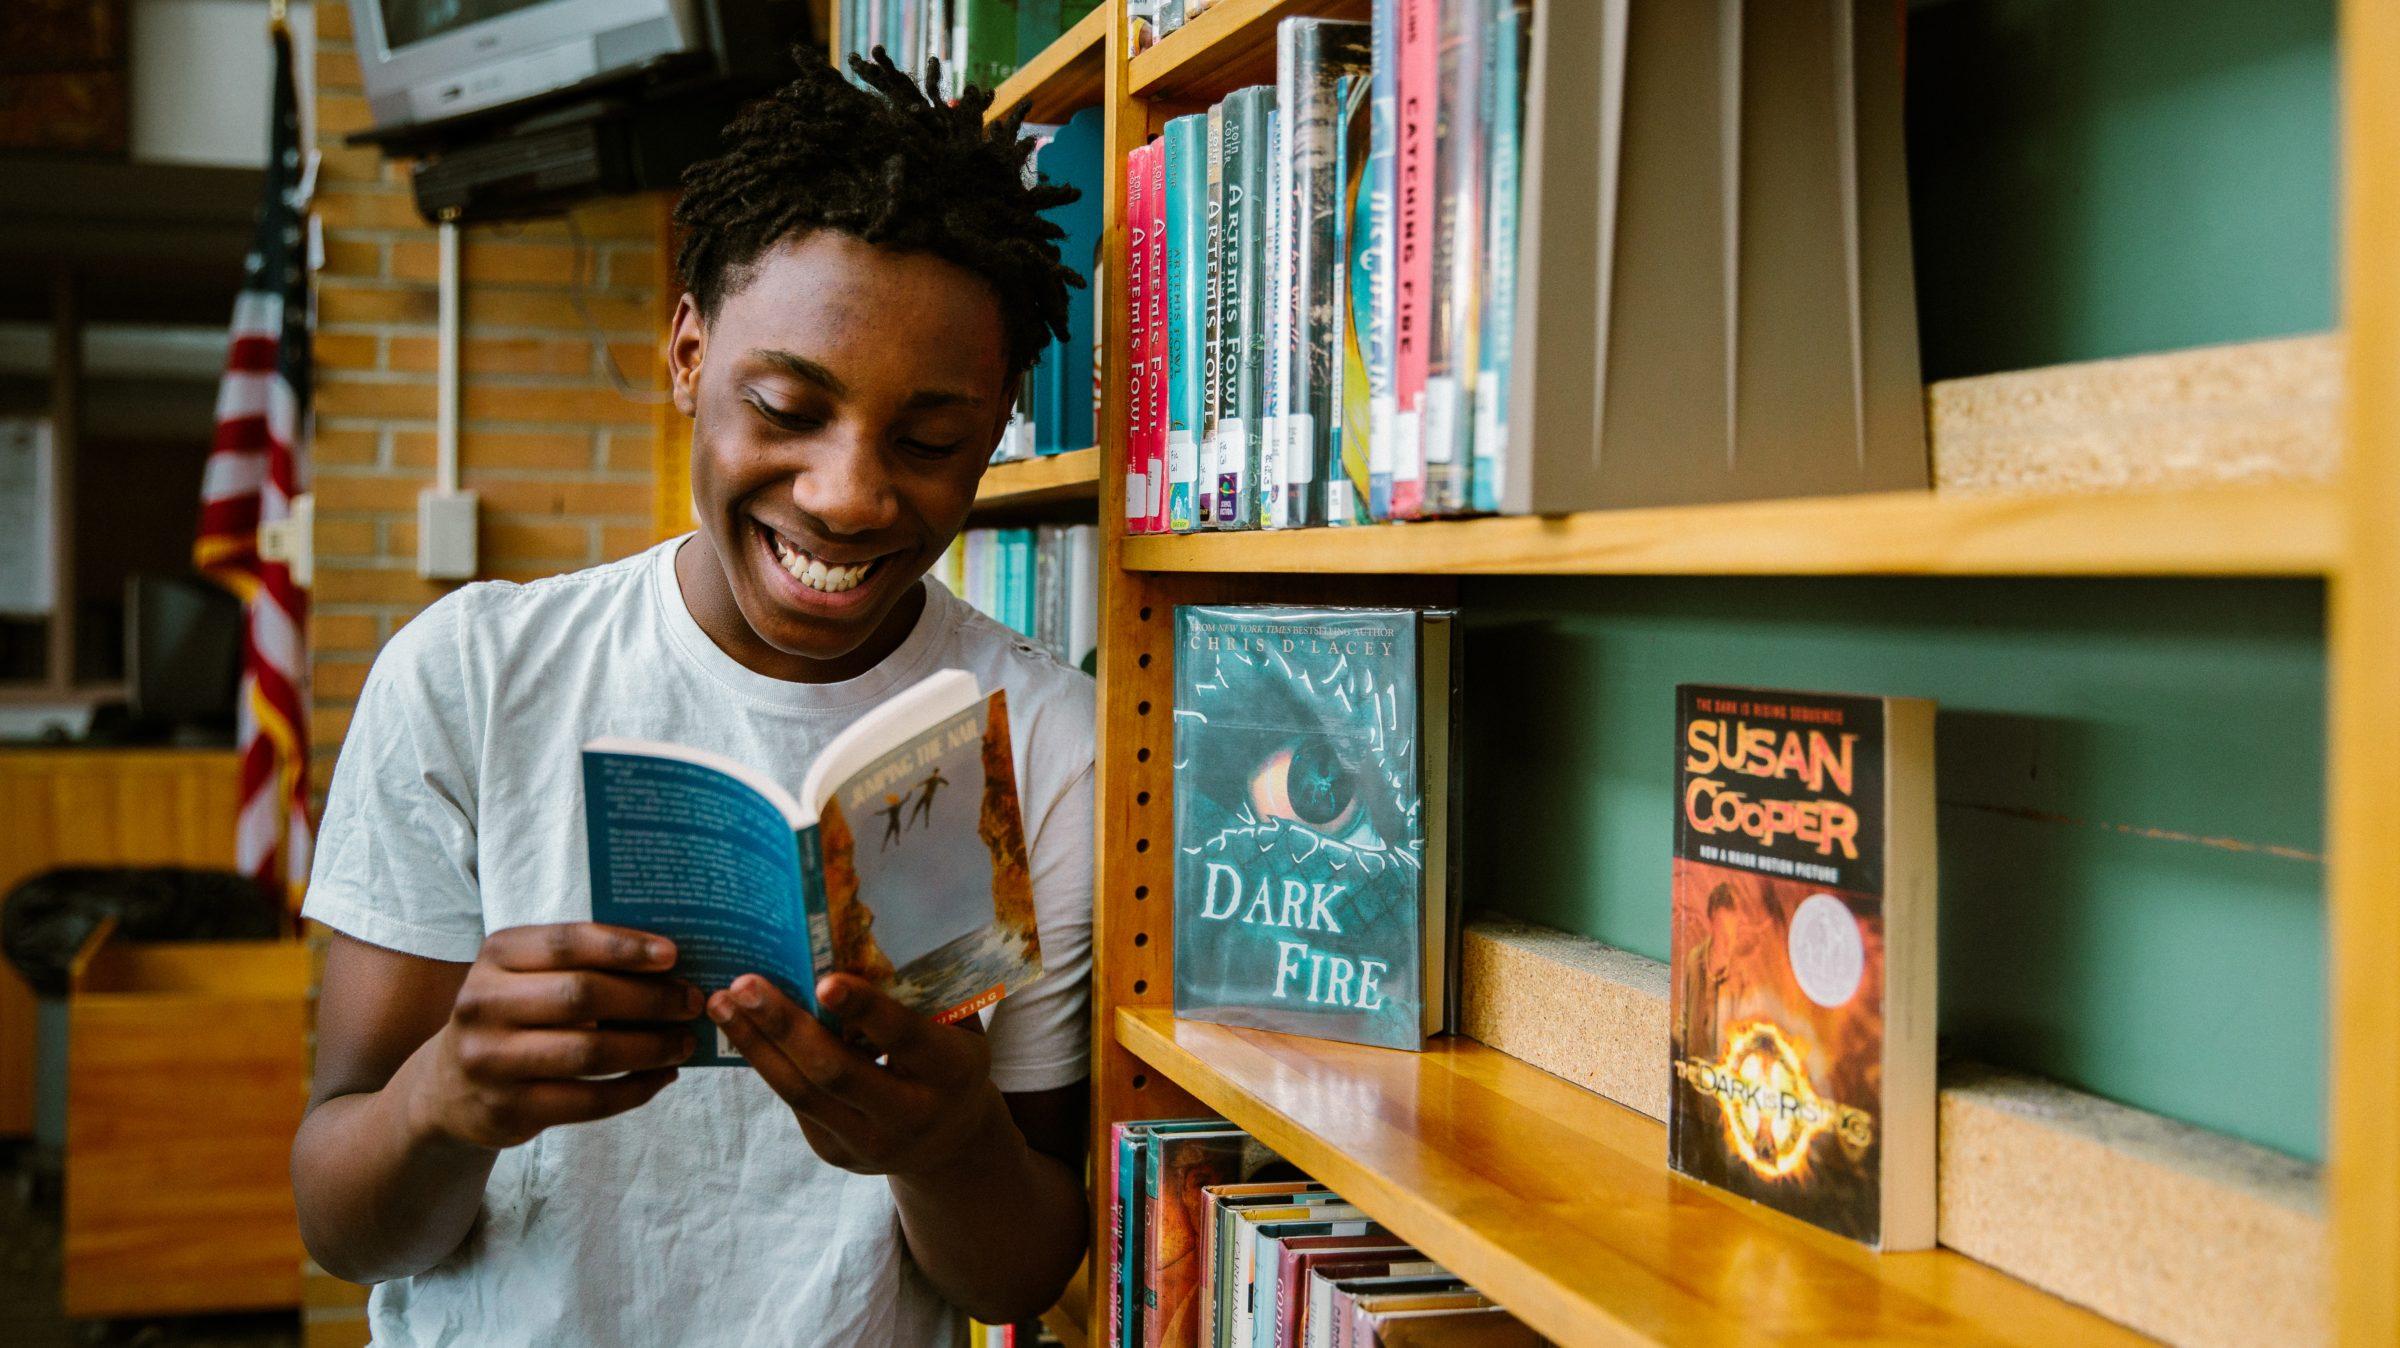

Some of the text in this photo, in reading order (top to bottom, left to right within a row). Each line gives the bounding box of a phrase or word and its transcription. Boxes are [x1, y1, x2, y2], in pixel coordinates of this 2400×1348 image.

[1223, 119, 1233, 168] COLFER
[1400, 96, 1419, 354] CATCHING FIRE
[1130, 227, 1146, 439] ARTEMIS FOWL
[1149, 218, 1166, 434] ARTEMIS FOWL
[1204, 201, 1222, 424] ARTEMIS FOWL
[1226, 183, 1243, 420] ARTEMIS FOWL
[1190, 636, 1393, 657] CHRIS D'LACEY
[1191, 623, 1395, 638] FROM NEW YORK TIMES BESTSELLING AUTHOR
[1685, 719, 1859, 796] SUSAN
[1685, 776, 1859, 860] COOPER
[1200, 862, 1348, 935] DARK
[1727, 849, 1757, 868] MAJOR
[1757, 855, 1794, 875] MOTION
[1794, 861, 1840, 884] PICTURE
[1272, 941, 1388, 1011] FIRE
[1699, 1064, 1761, 1111] DARK
